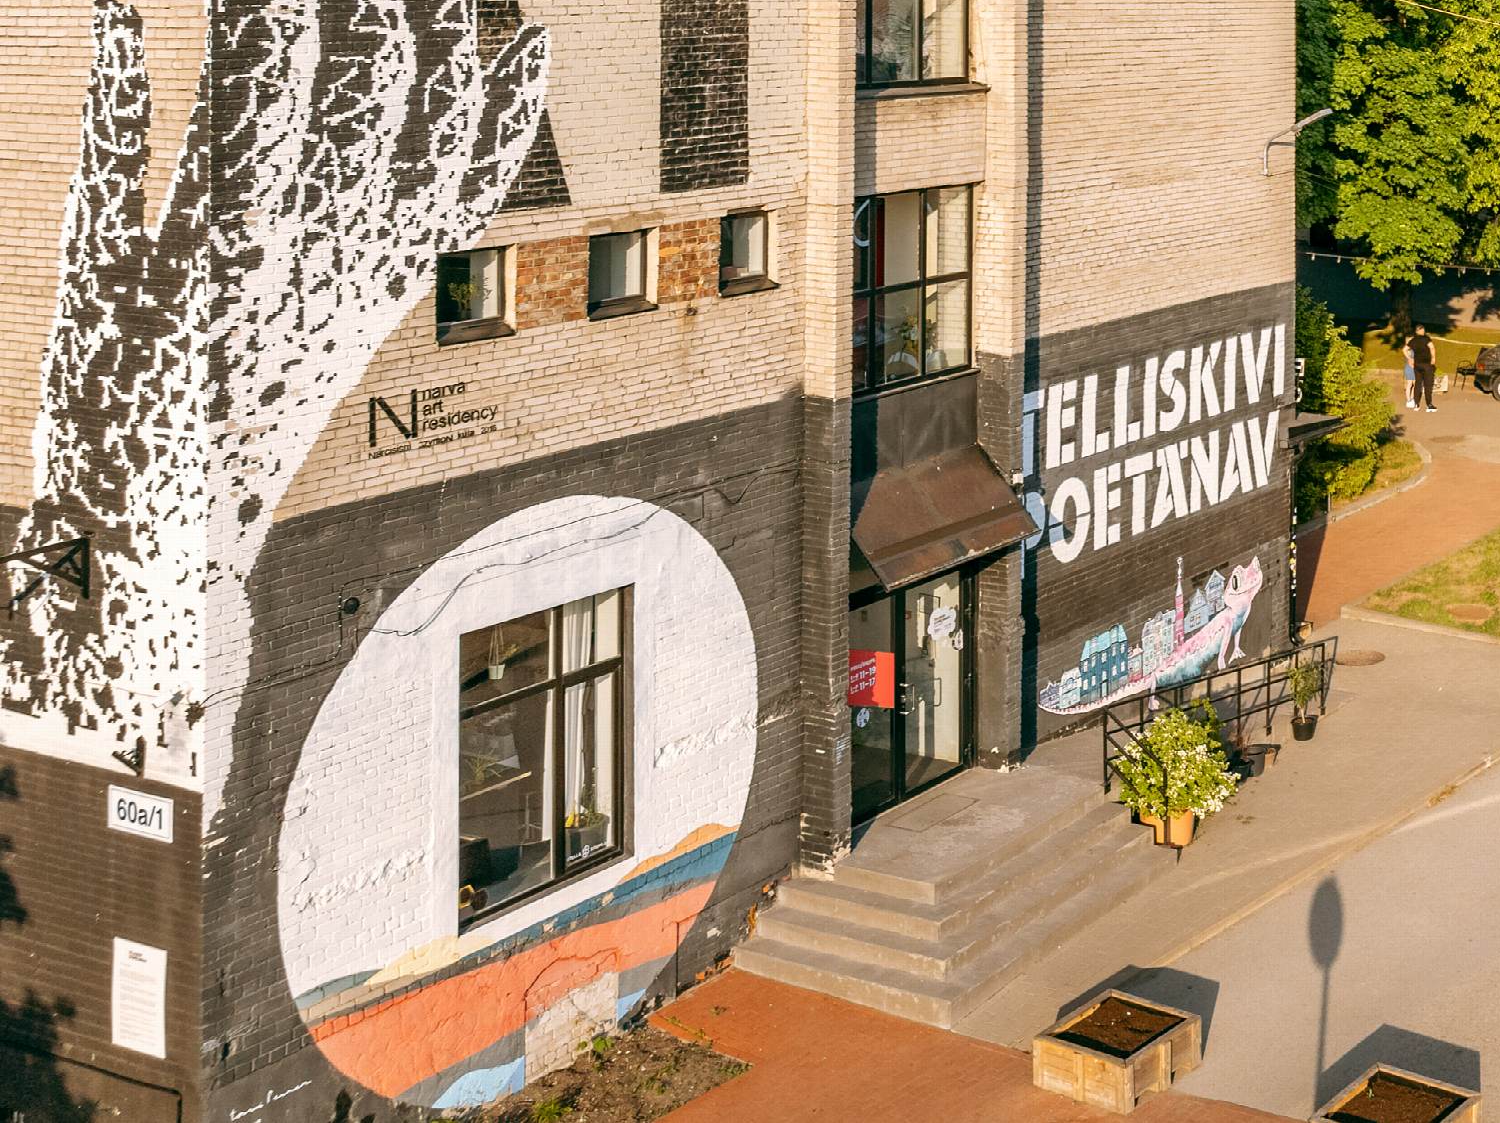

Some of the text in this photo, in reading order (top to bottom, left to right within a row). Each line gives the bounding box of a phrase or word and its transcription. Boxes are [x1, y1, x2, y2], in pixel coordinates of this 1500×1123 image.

[421, 381, 466, 401] narva
[1022, 323, 1285, 478] TELLISKIVI
[422, 400, 444, 416] art
[422, 405, 498, 432] residency
[1021, 409, 1280, 579] POETÄNAV
[117, 798, 164, 830] 60a/1
